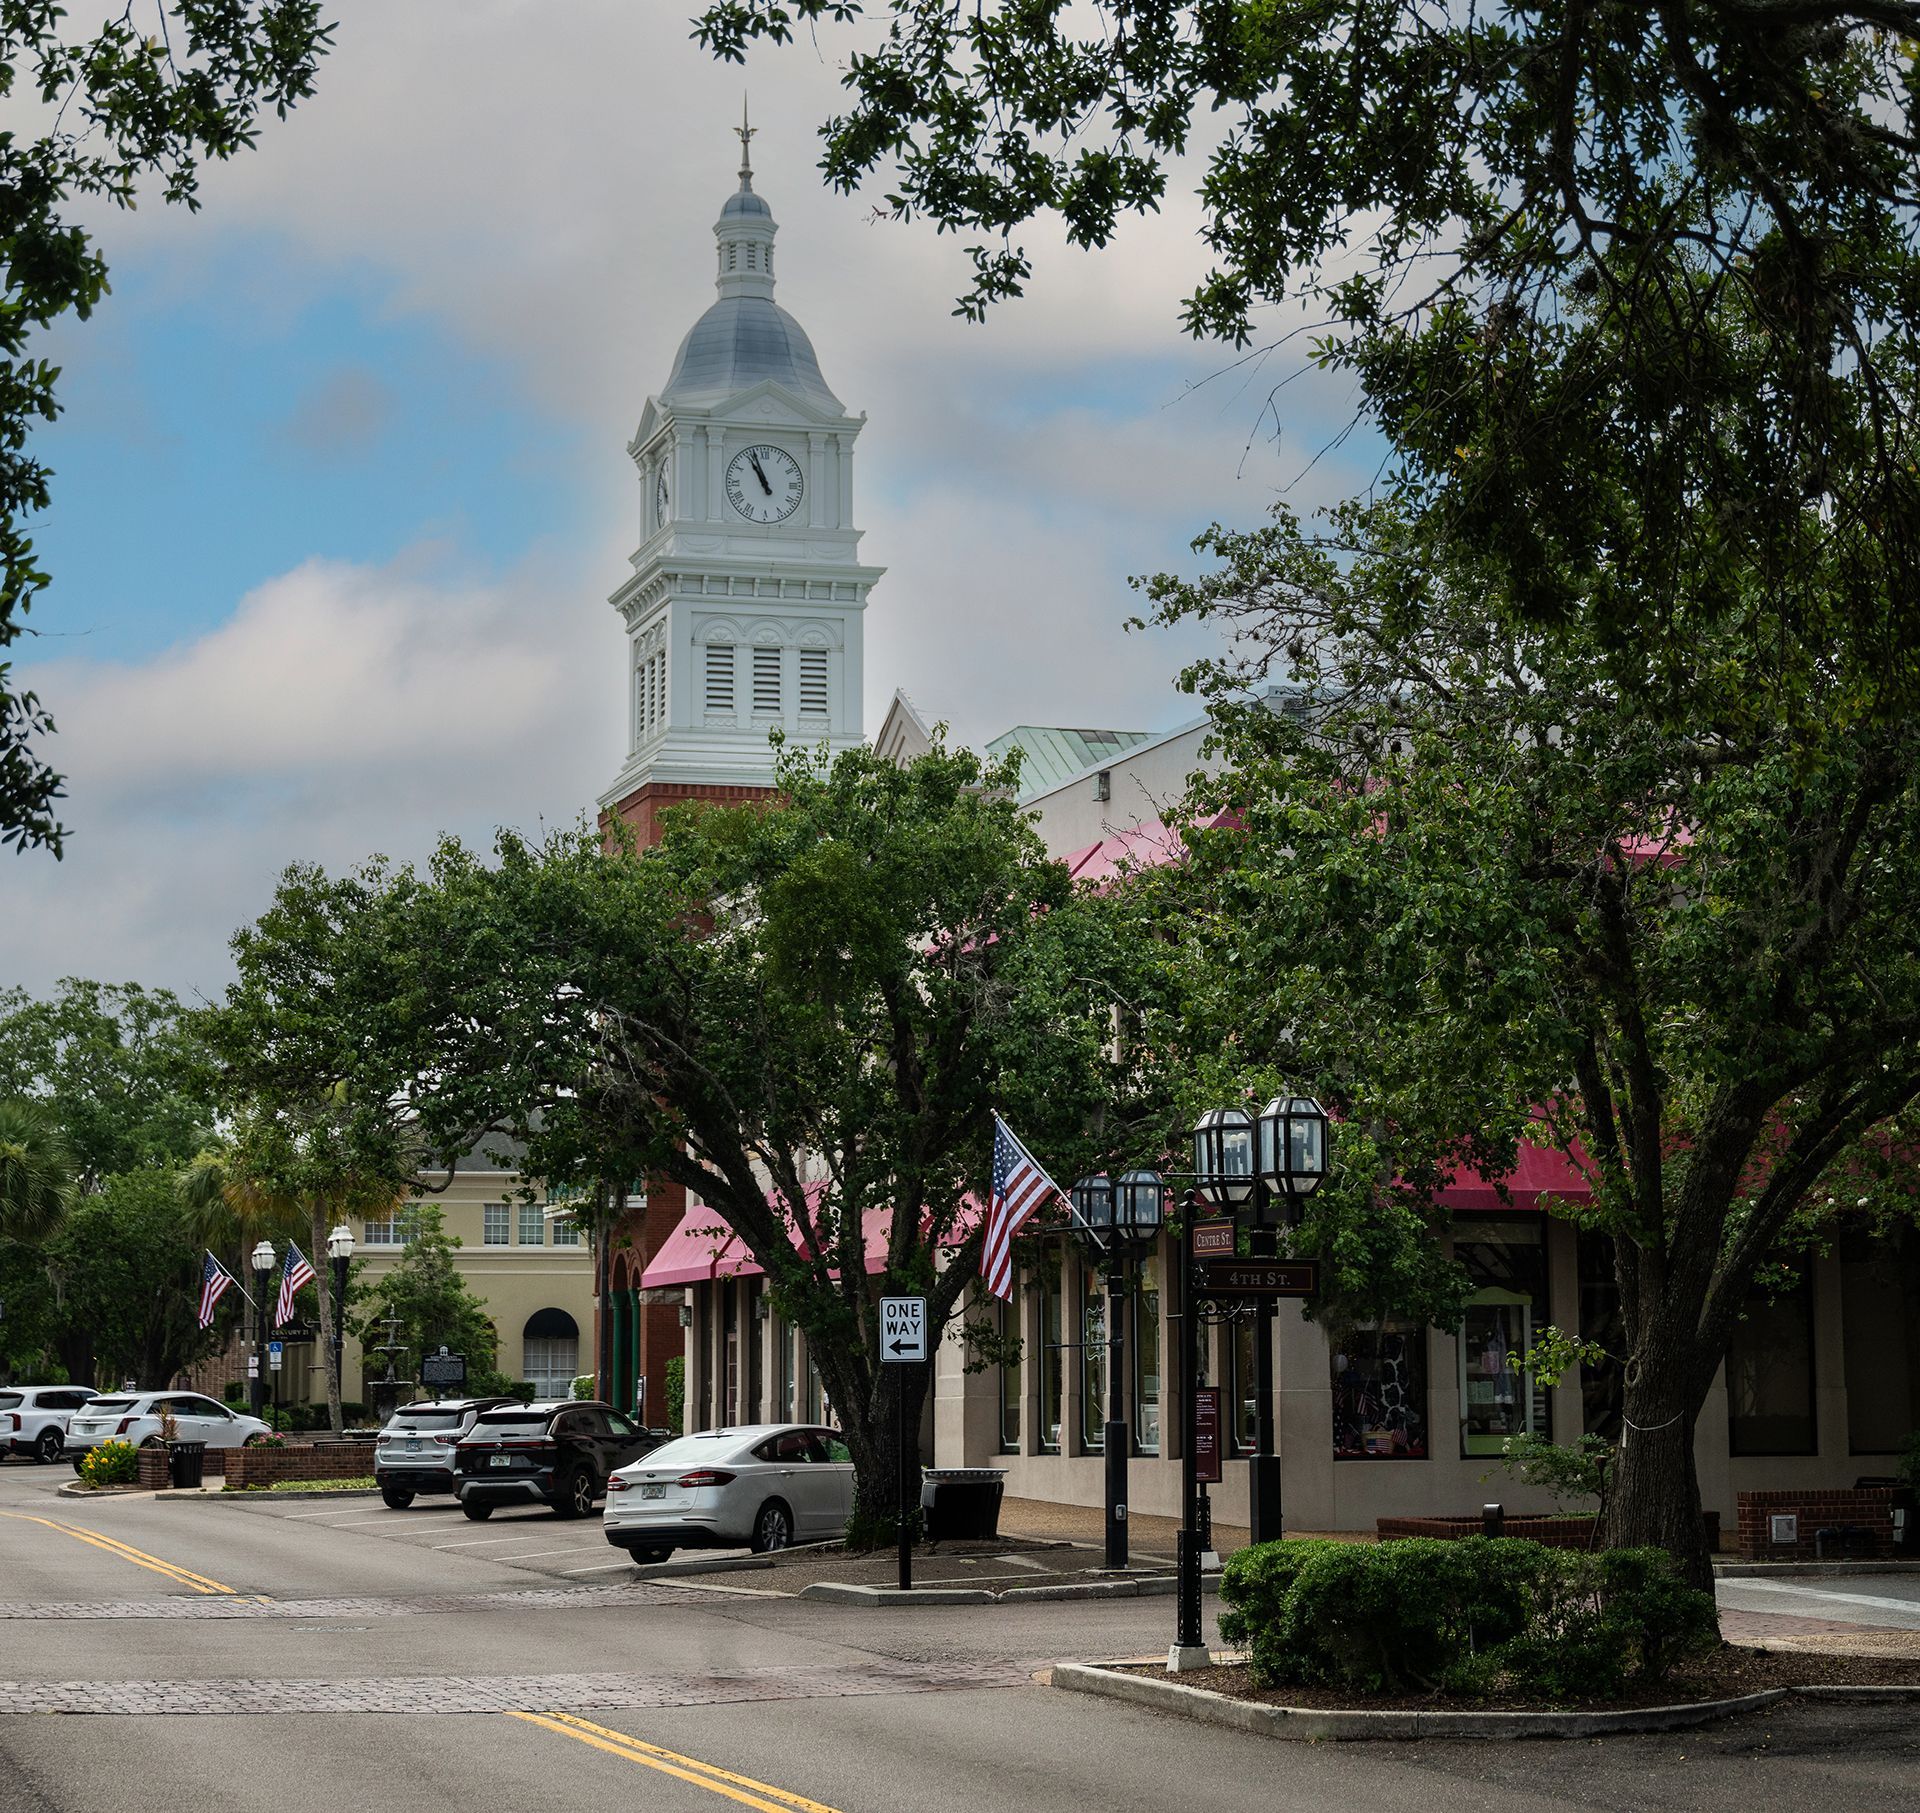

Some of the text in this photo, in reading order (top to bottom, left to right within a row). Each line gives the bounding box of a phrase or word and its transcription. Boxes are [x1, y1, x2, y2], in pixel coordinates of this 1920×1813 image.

[1197, 1232, 1231, 1247] CENTRE ST.
[1230, 1271, 1291, 1285] 4TH ST.
[887, 1304, 920, 1318] ONE
[887, 1321, 921, 1335] WAY
